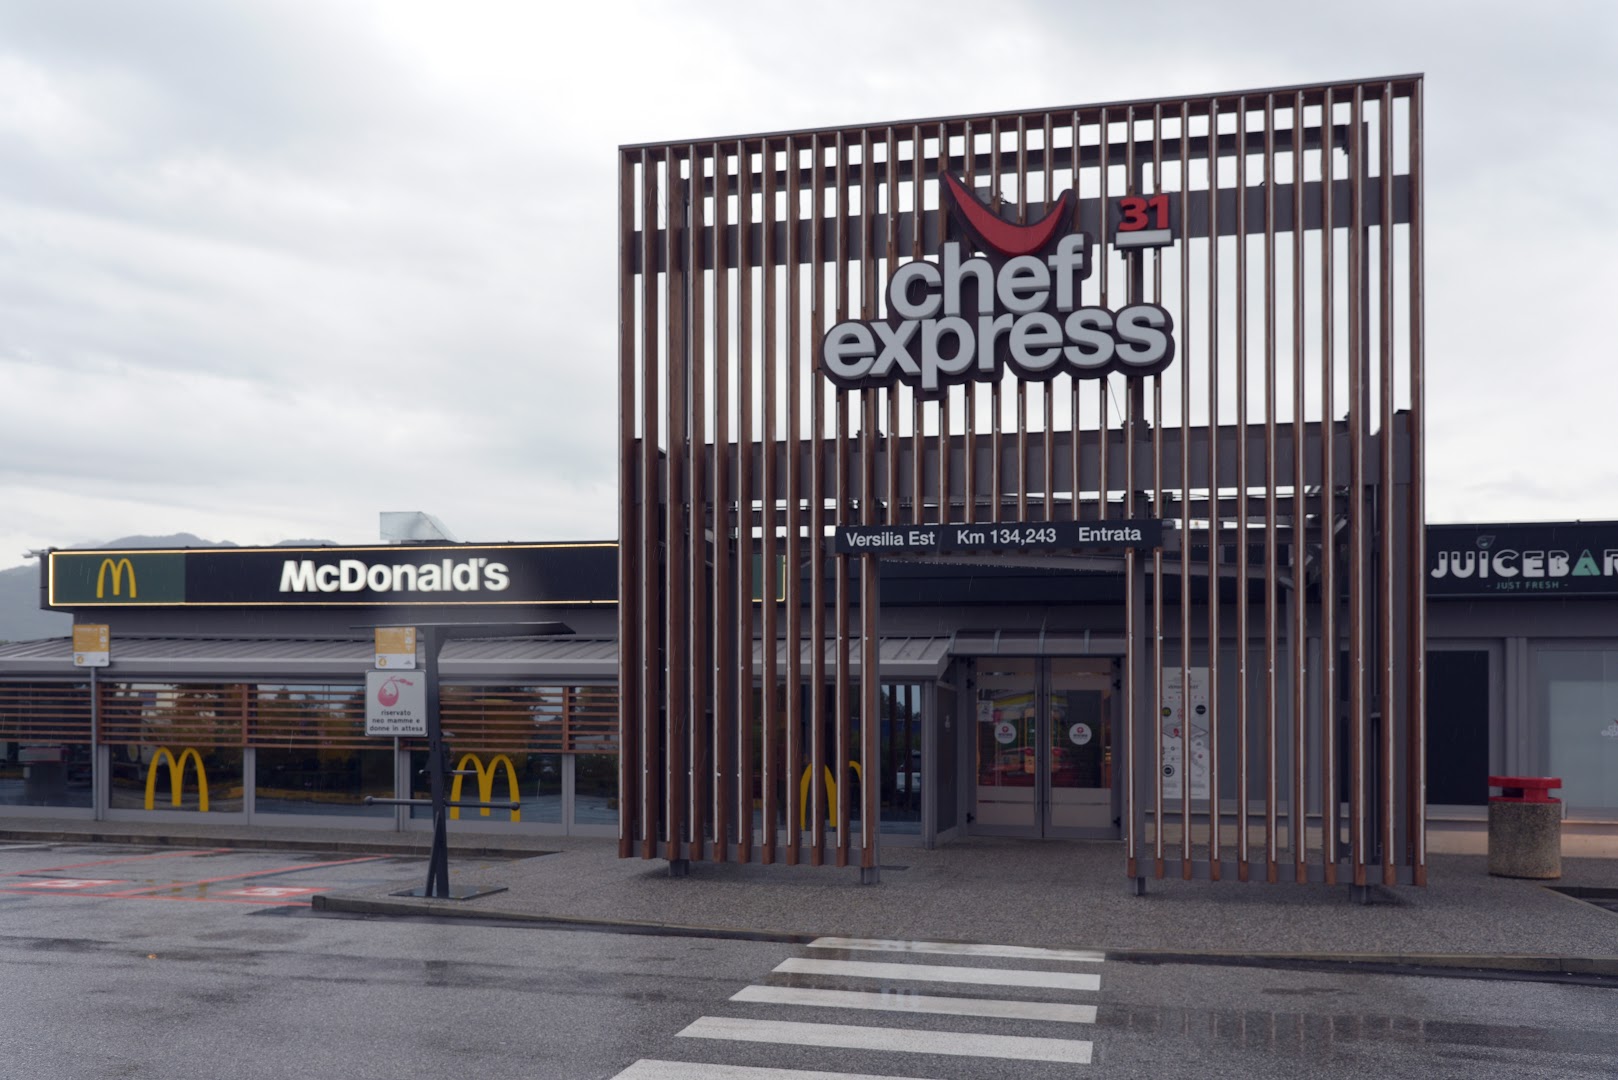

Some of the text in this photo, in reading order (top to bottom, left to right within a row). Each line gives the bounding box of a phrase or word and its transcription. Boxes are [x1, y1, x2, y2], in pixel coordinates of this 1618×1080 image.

[1118, 194, 1170, 232] 31
[889, 233, 1085, 320] chef
[823, 305, 1168, 391] express
[846, 526, 1142, 547] Versilia Est Km 134,243 Entrata
[279, 557, 510, 592] McDonald's
[1496, 581, 1559, 590] JUST FRESH
